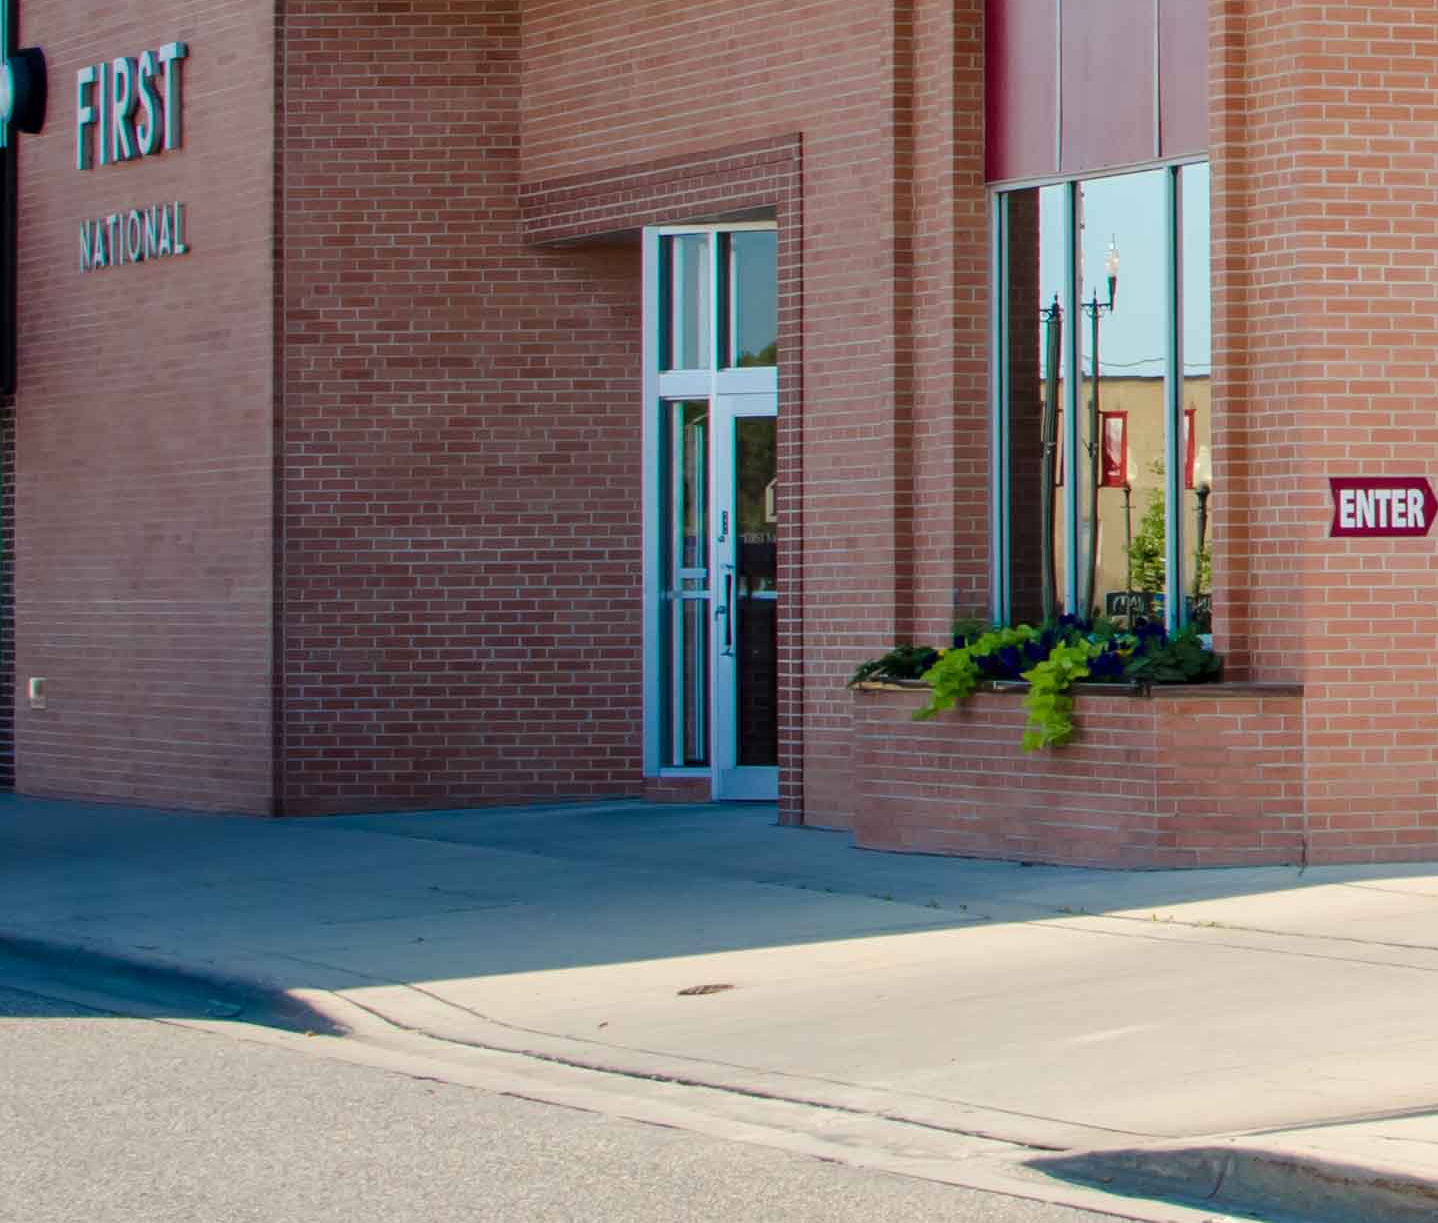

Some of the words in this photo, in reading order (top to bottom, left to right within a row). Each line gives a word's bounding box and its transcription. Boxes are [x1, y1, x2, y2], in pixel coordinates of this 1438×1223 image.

[76, 41, 187, 170] FIRST
[79, 200, 189, 273] NATIONAL
[1340, 488, 1426, 529] ENTER
